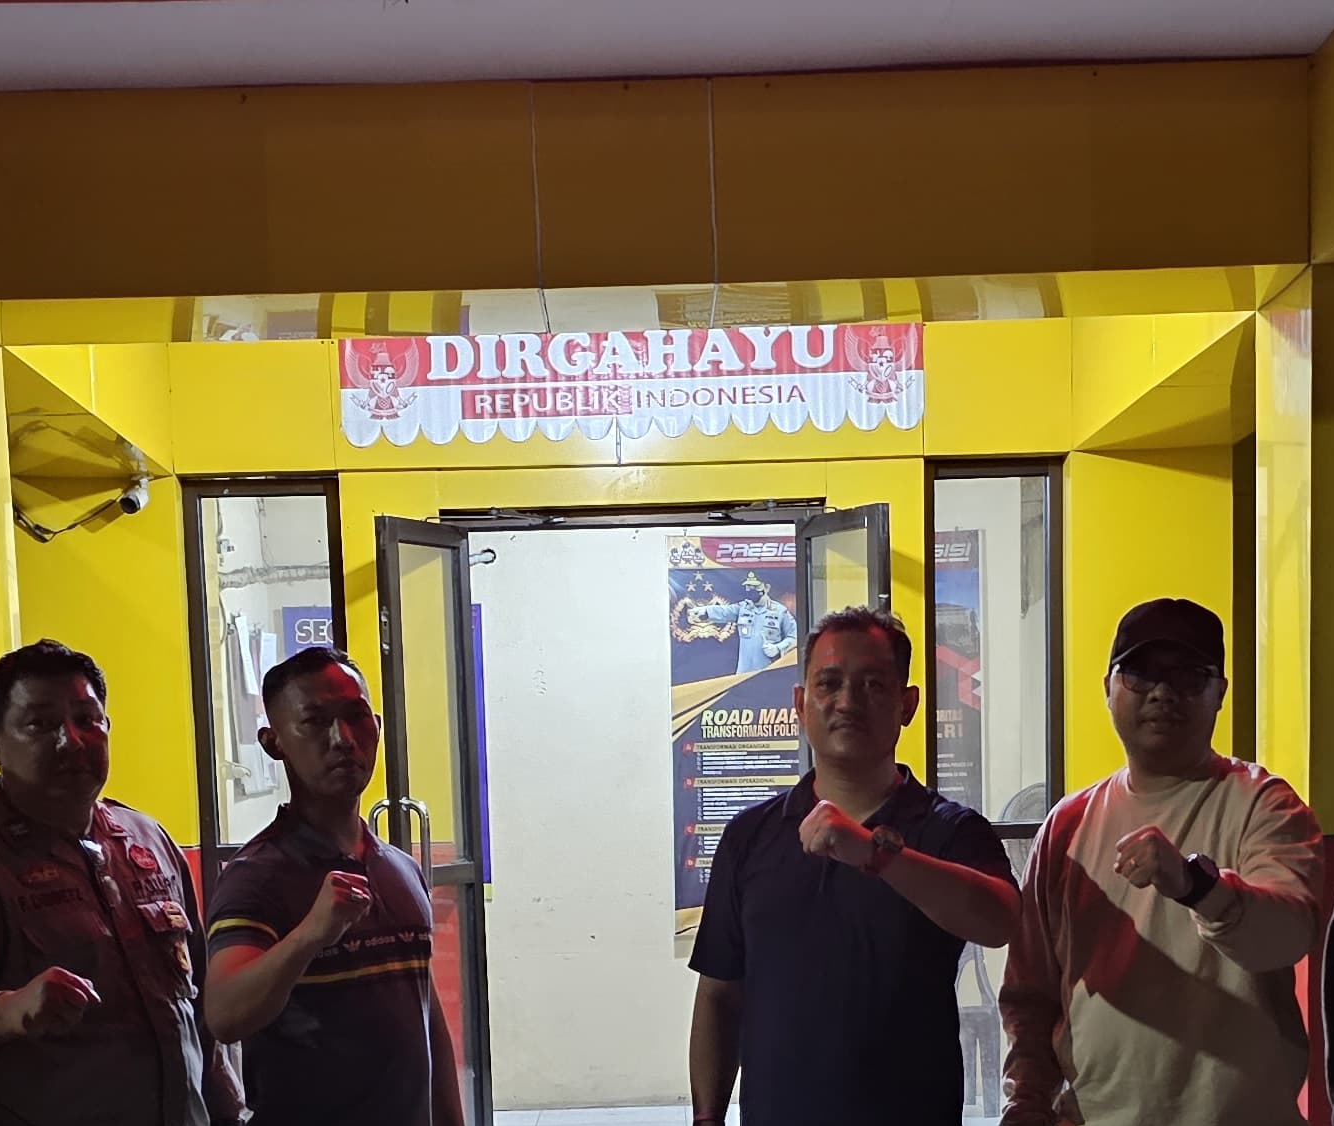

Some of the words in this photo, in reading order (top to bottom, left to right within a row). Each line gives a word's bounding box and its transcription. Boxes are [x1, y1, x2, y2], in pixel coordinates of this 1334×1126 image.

[426, 325, 838, 382] DIRGAHAYU
[474, 390, 620, 414] REPUBLIK
[636, 385, 807, 408] INDONESIA
[715, 542, 797, 557] PRESIS
[700, 709, 754, 725] ROAD
[701, 724, 772, 738] TRANSFORMASI
